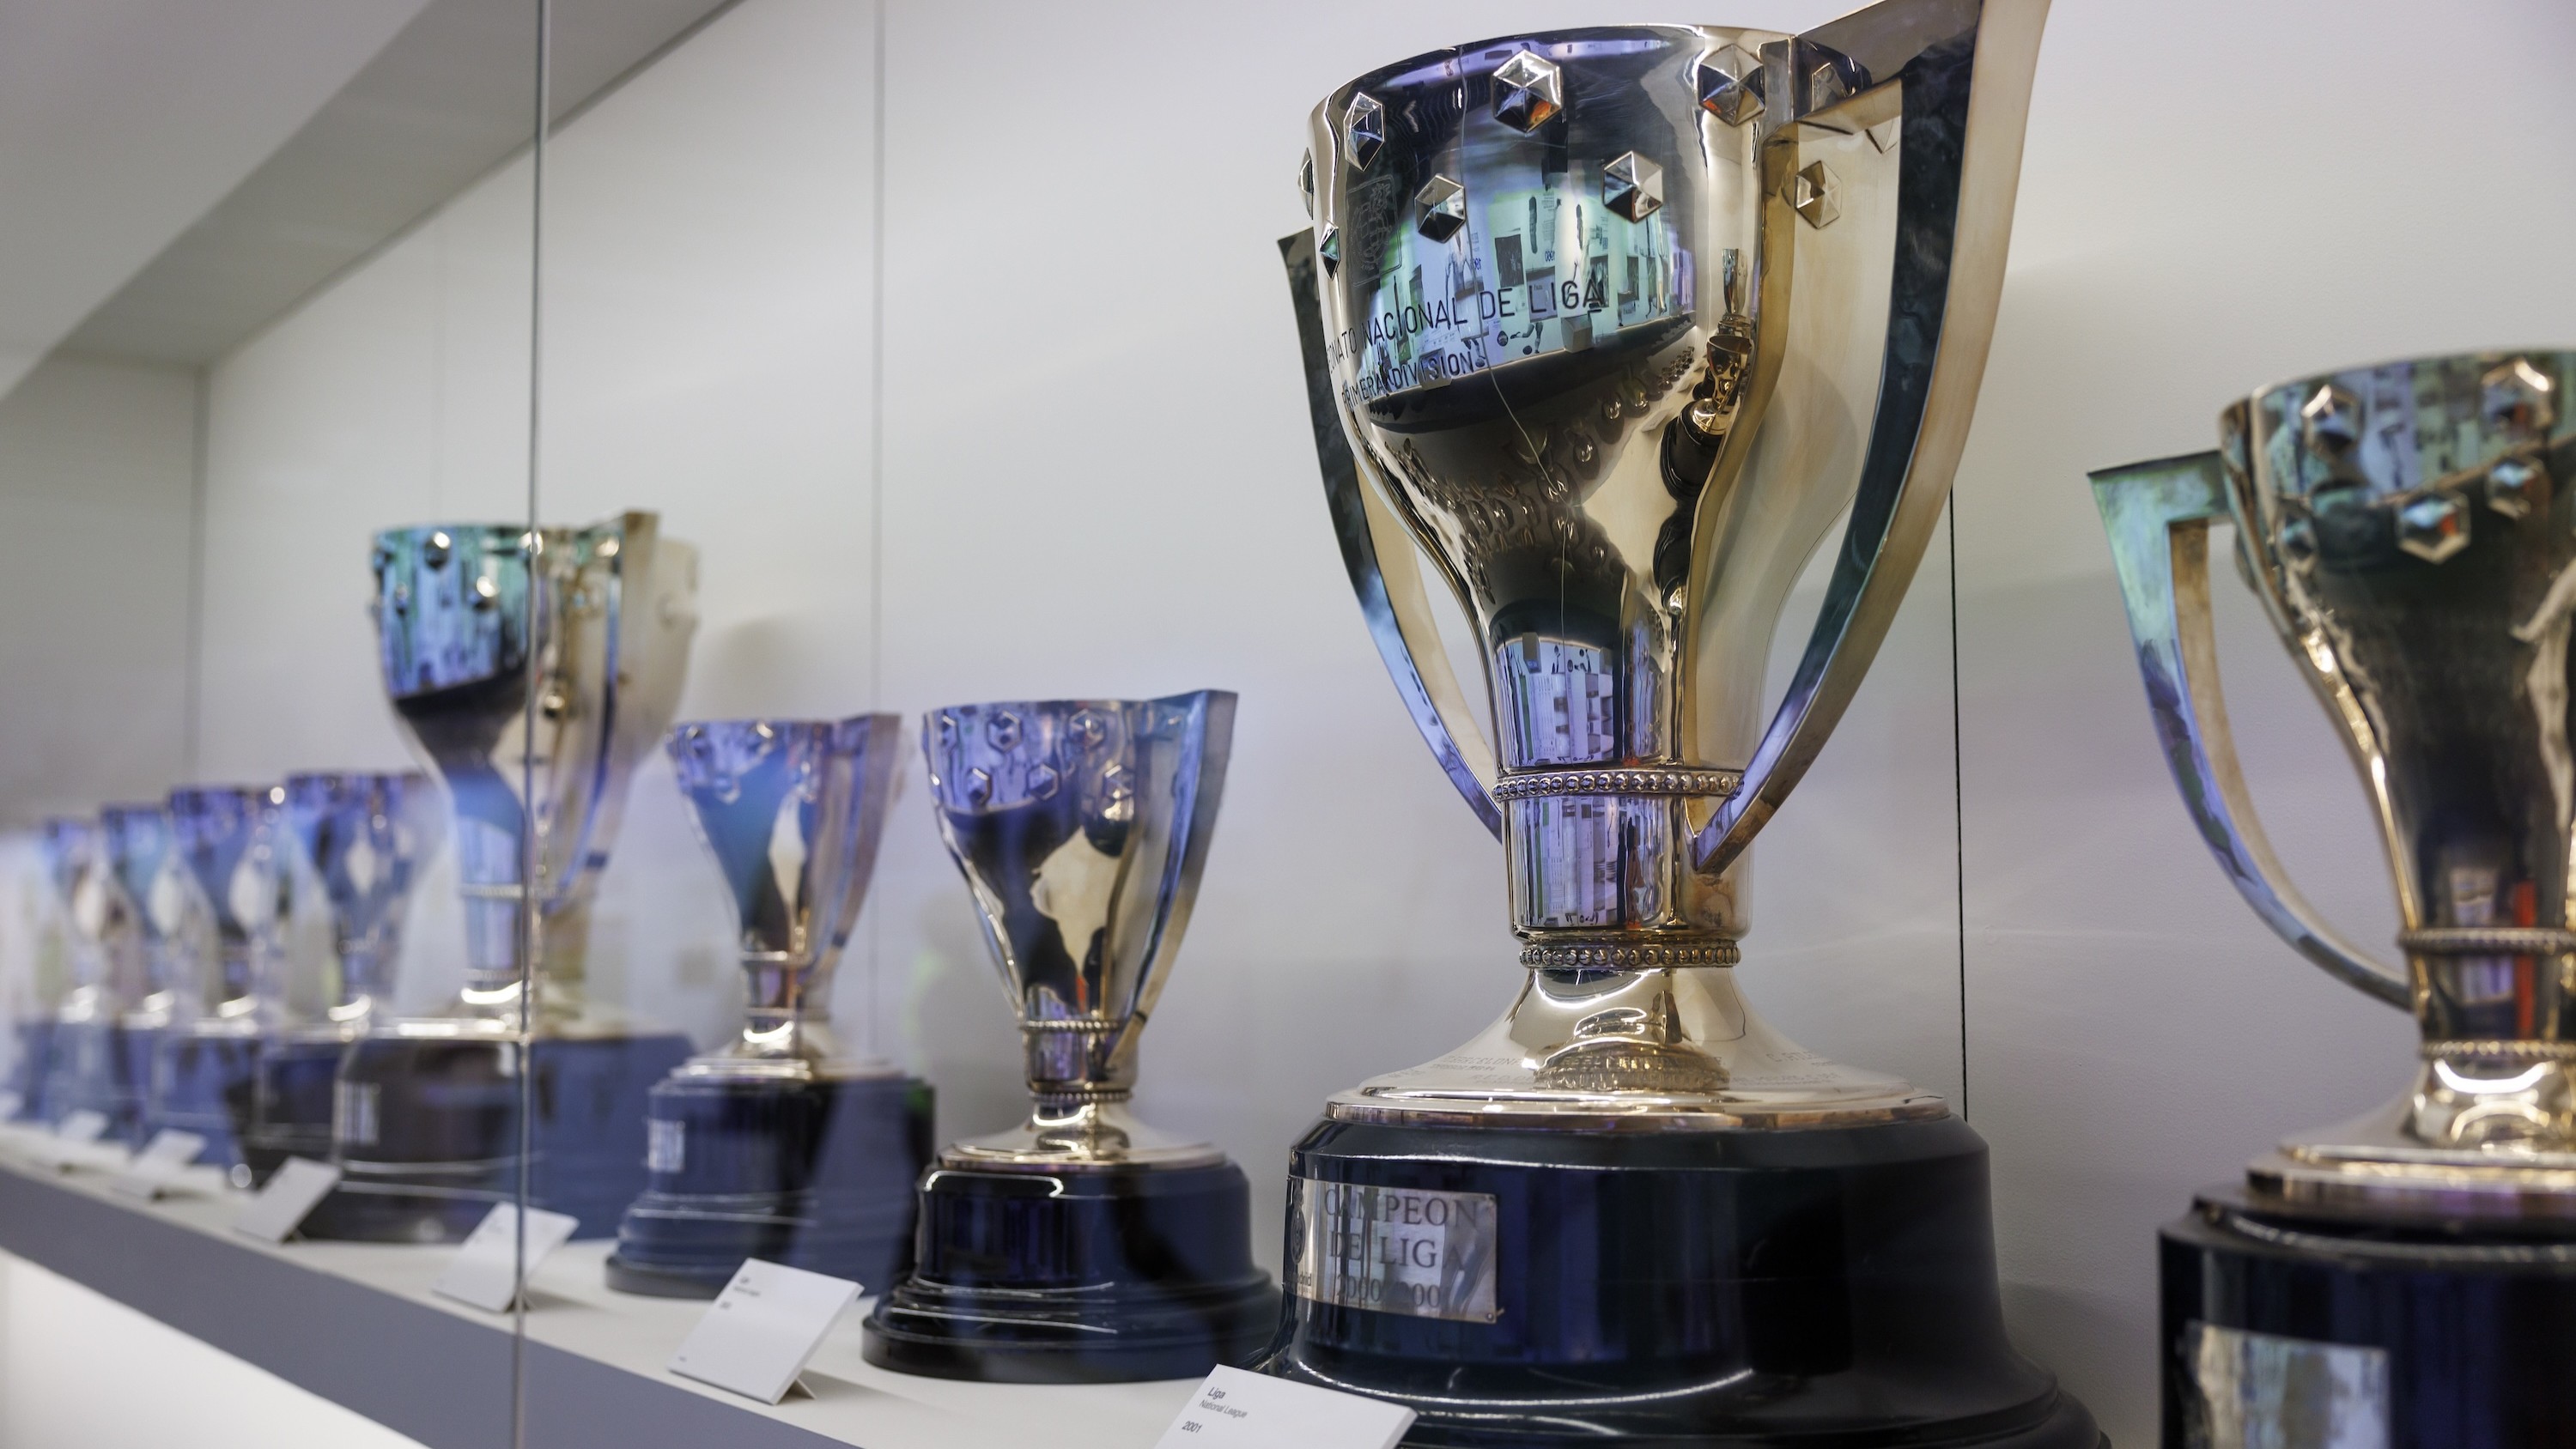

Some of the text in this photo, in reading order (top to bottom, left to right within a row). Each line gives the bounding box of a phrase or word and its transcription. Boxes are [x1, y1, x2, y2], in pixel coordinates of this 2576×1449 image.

[1361, 297, 1468, 350] NACIONAL
[1479, 288, 1516, 320] DE
[1528, 278, 1605, 314] LIGA
[1341, 350, 1475, 409] PRIMERA DIVISION
[1328, 1230, 1465, 1270] DE LIGA
[1207, 1386, 1226, 1400] Liga
[1199, 1399, 1248, 1418] National League
[1182, 1421, 1203, 1434] 2001
